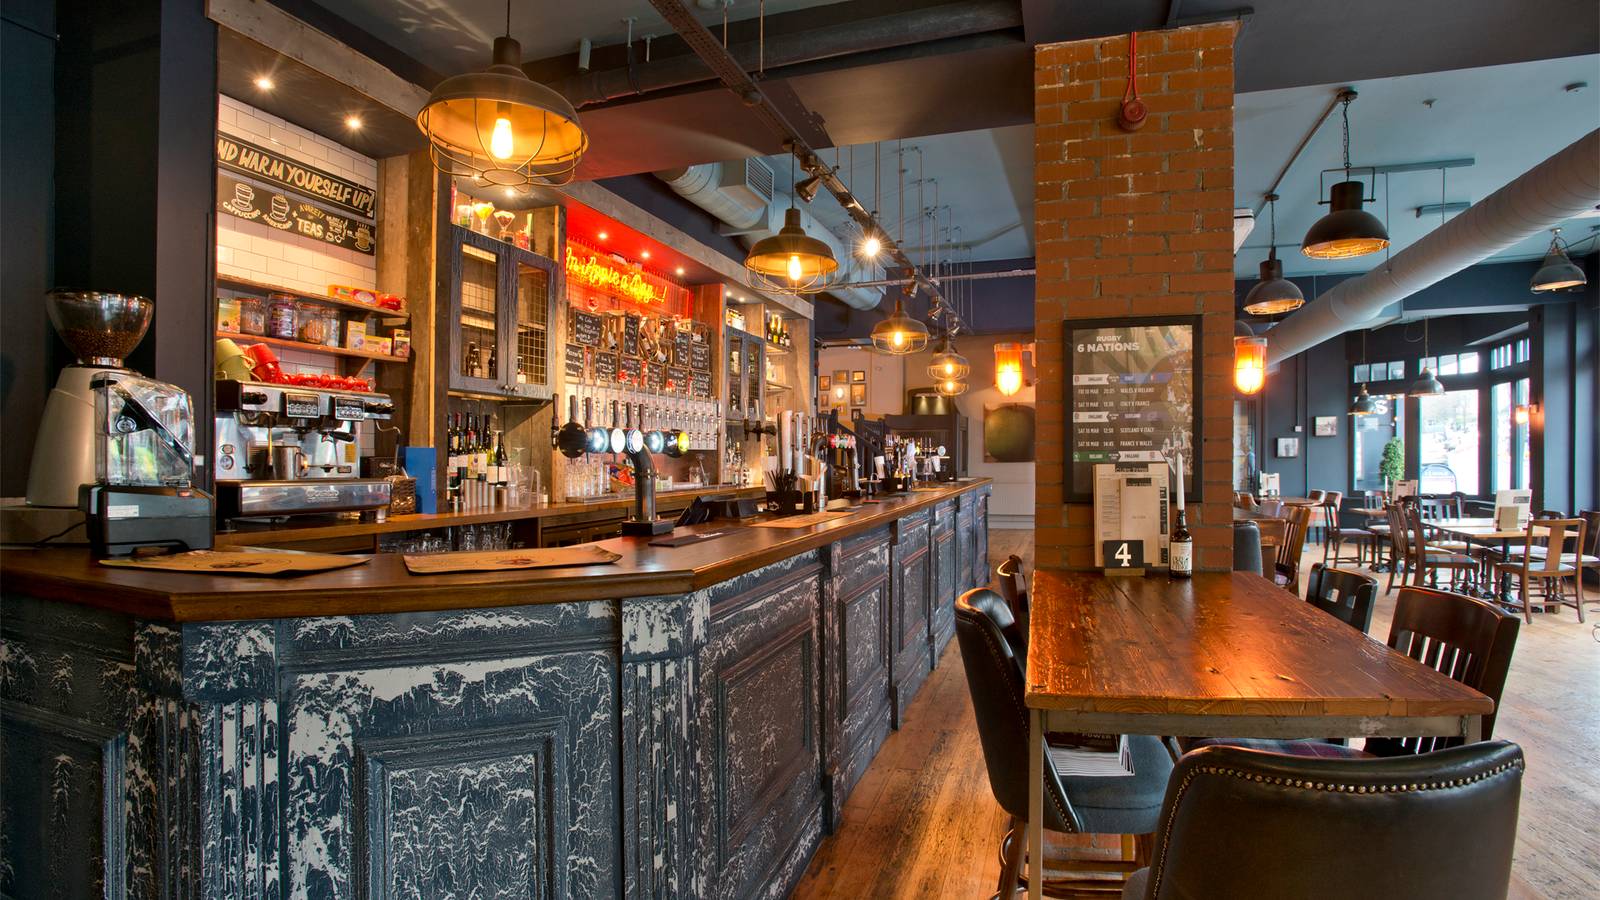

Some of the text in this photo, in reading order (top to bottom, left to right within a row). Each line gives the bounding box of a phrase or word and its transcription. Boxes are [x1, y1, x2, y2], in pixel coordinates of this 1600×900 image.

[238, 147, 284, 180] WARM
[286, 164, 352, 203] YOURSELF
[297, 218, 324, 239] TEAS
[1077, 342, 1140, 353] 6 NATIONS
[1114, 543, 1132, 567] 4
